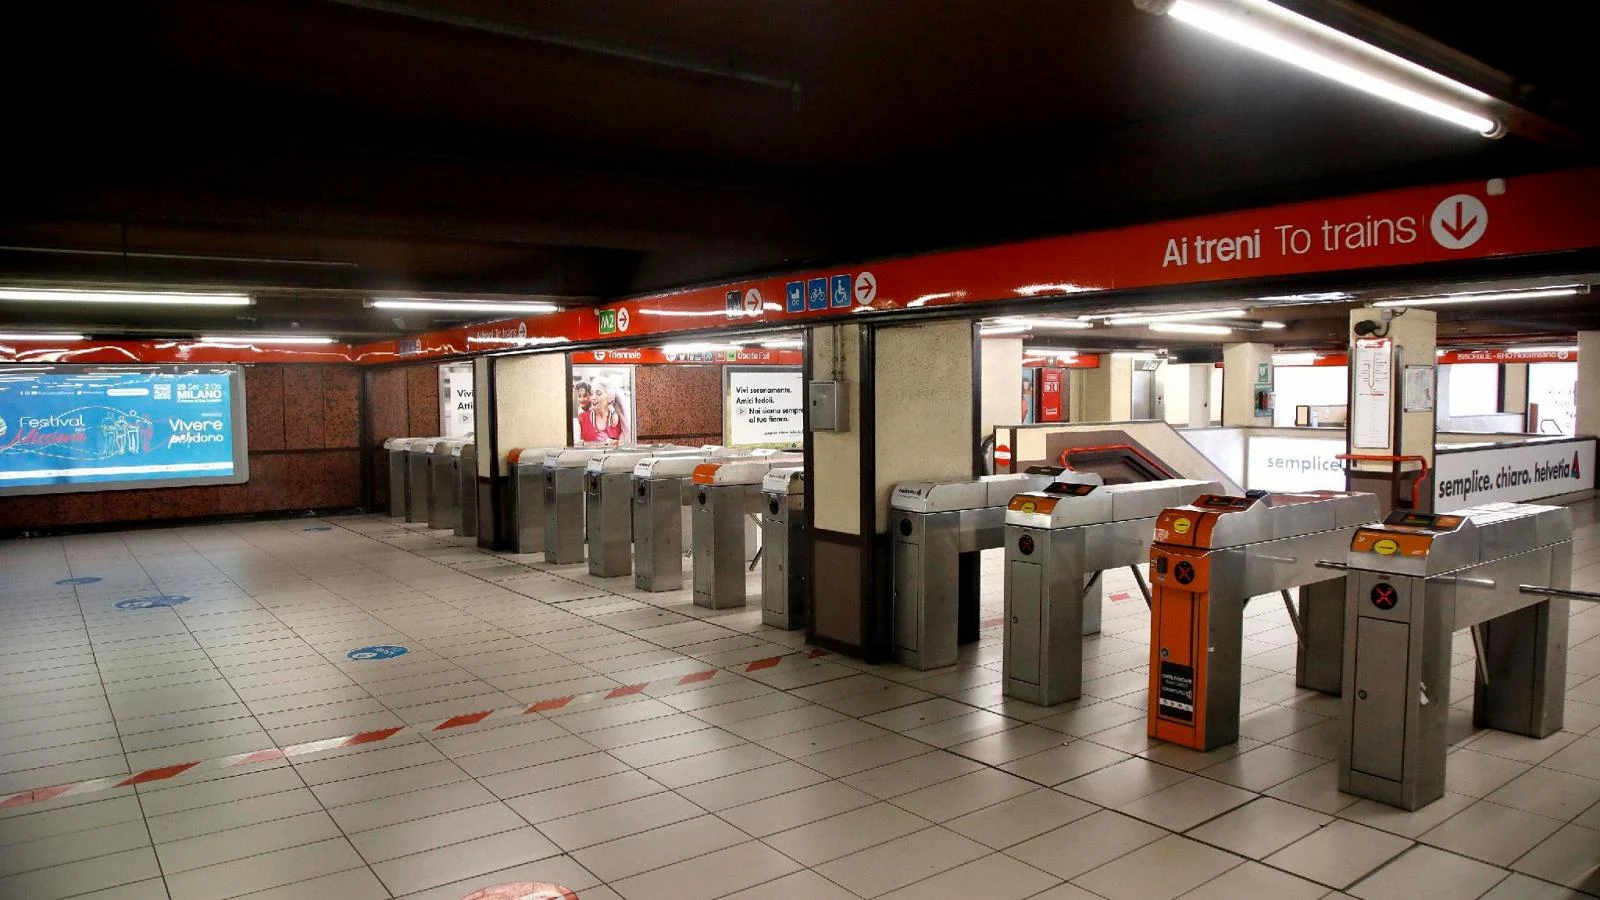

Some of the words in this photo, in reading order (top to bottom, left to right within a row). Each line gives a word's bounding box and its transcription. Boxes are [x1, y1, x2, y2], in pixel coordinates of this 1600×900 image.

[1163, 237, 1188, 268] Ai
[1195, 228, 1261, 264] treni
[1274, 224, 1311, 255] To
[1322, 214, 1417, 250] trains
[601, 314, 614, 329] M2
[608, 350, 641, 360] Triennale
[177, 390, 222, 400] MILANO
[736, 386, 749, 394] Vivi
[736, 397, 754, 405] Amici
[749, 407, 761, 415] Noi
[20, 415, 86, 428] Festival
[169, 418, 223, 431] Vivere
[1438, 470, 1494, 501] semplice.
[1496, 465, 1532, 489] chiaro.
[1534, 459, 1571, 483] helvetia
